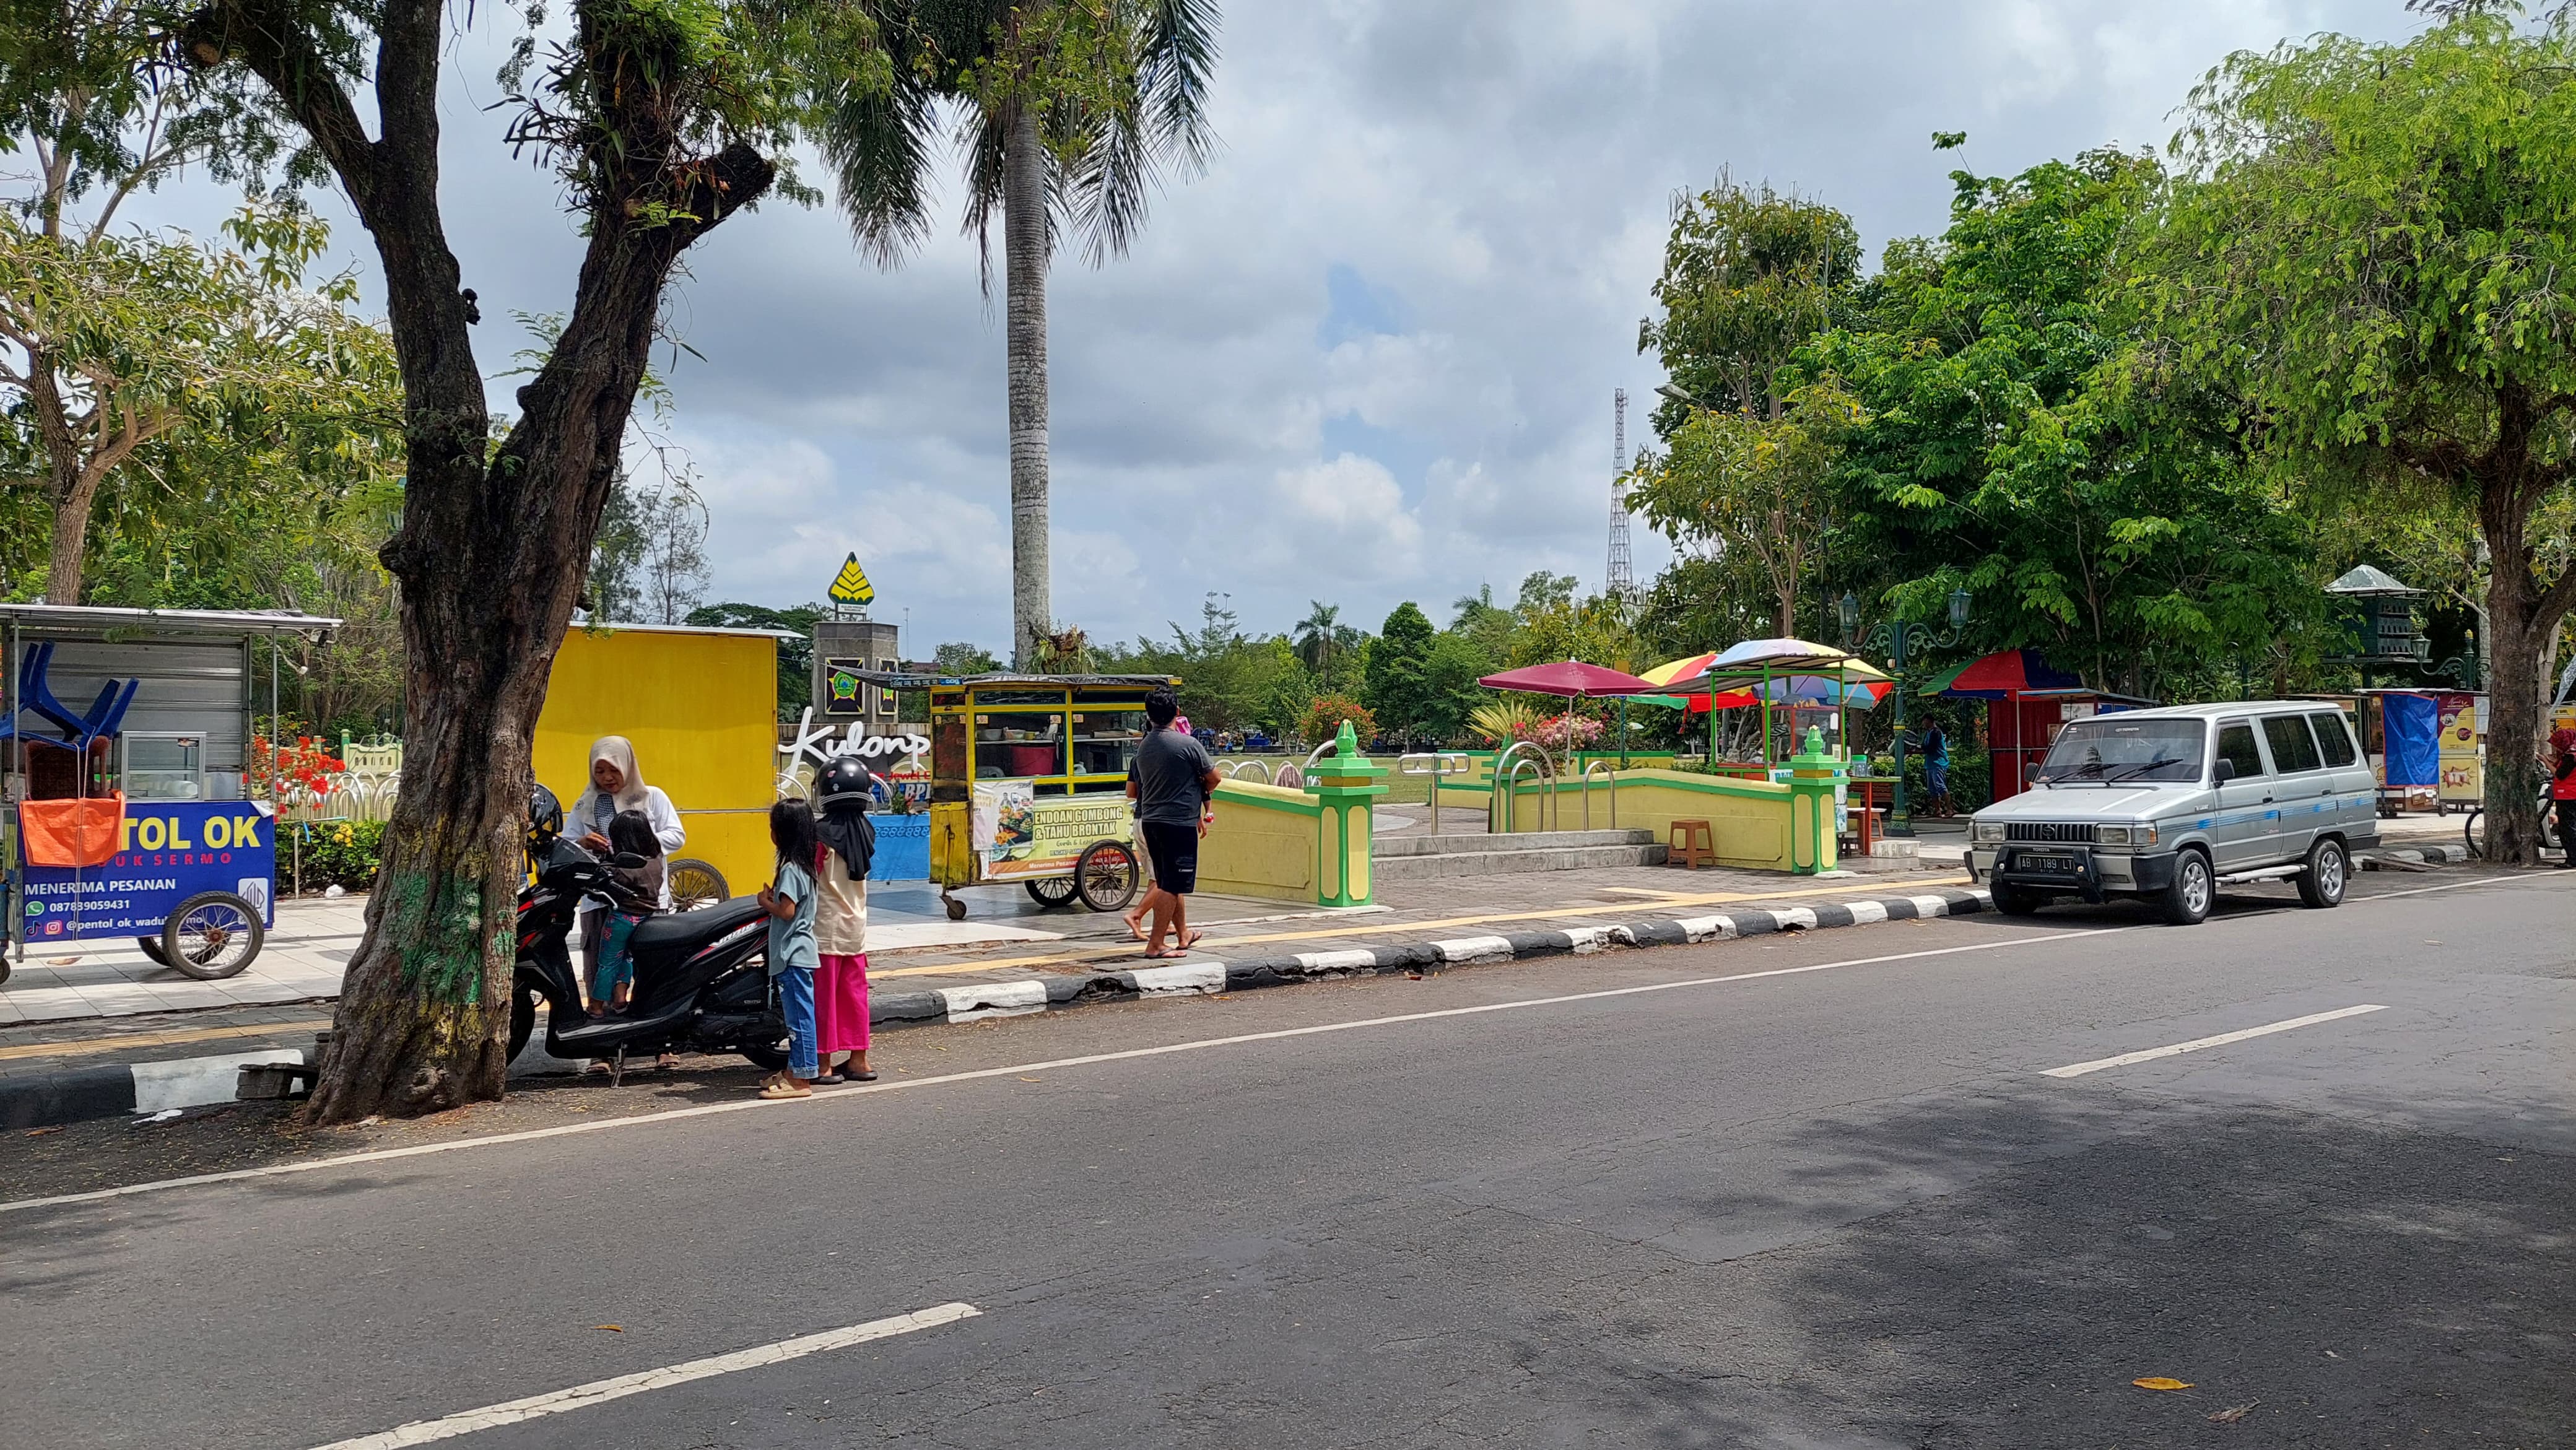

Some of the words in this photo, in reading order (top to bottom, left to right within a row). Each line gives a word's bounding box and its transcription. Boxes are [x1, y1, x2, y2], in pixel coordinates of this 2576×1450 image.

[1033, 809, 1073, 825] ENDOAN
[1074, 807, 1123, 822] GOMBONG
[203, 816, 261, 849] OK
[1035, 828, 1043, 840] &
[1045, 824, 1071, 839] TAHU
[1071, 822, 1116, 837] BRONTAK
[154, 853, 232, 866] SERMO
[2022, 857, 2031, 867] AB
[2038, 859, 2057, 869] 1189
[2063, 859, 2072, 870] LT
[24, 881, 105, 895] MENERIMA
[109, 879, 176, 892] PESANAN
[49, 900, 129, 913] 087839059431
